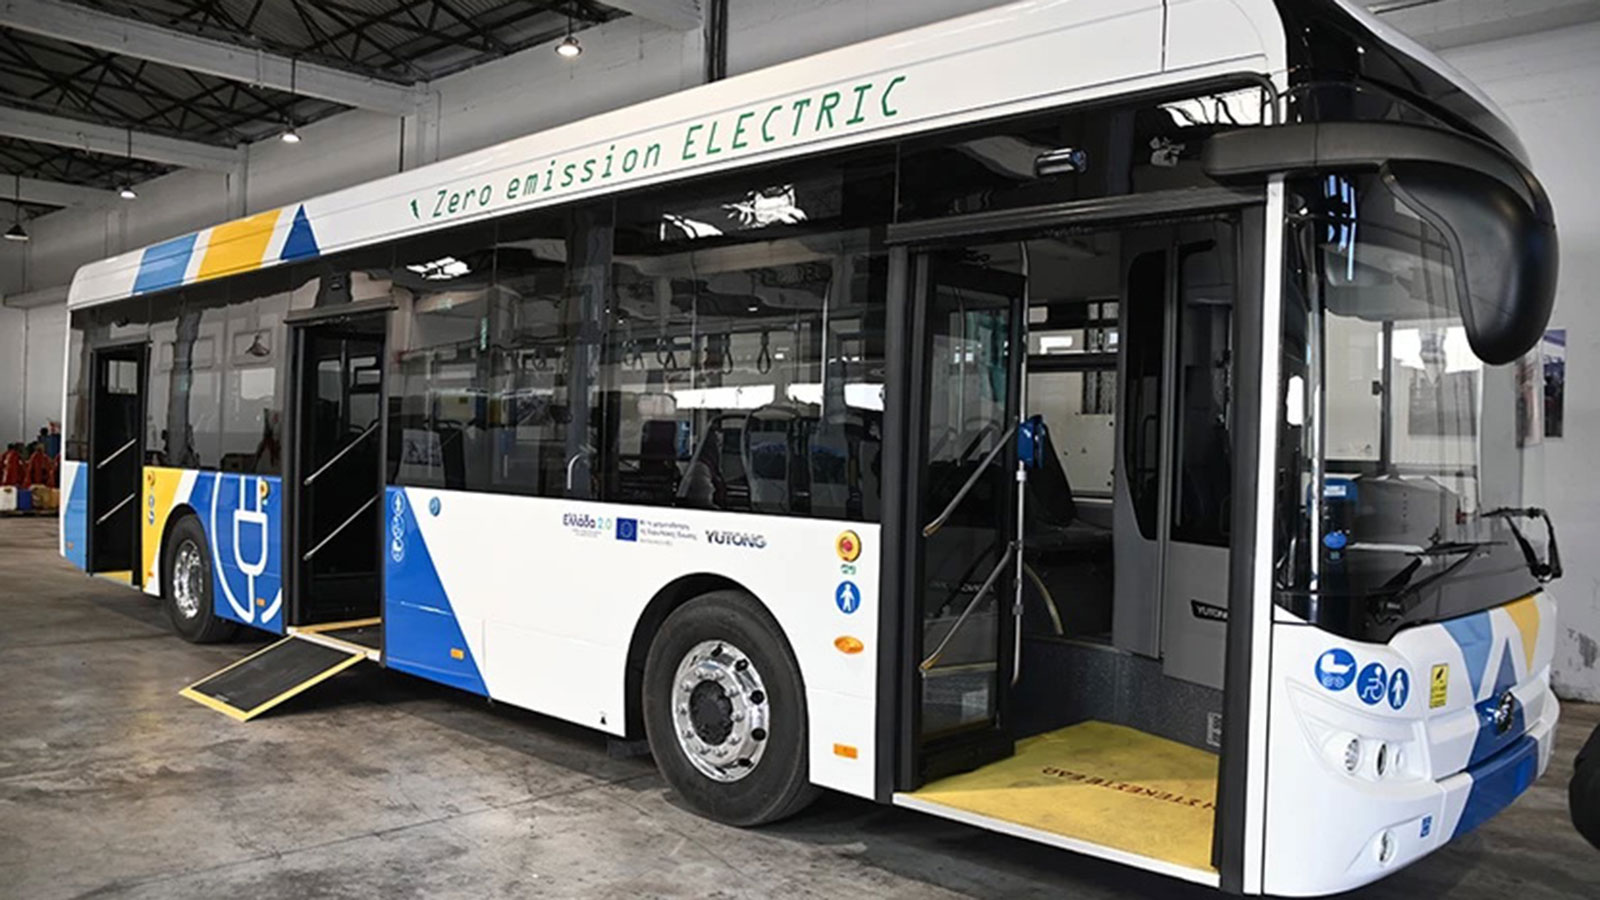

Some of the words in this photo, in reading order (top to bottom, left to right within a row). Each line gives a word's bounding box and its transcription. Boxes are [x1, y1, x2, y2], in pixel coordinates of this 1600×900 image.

[432, 184, 493, 218] Zero
[506, 142, 662, 200] emission
[681, 75, 907, 161] ELECTRIC
[704, 529, 768, 549] YUTONG
[1195, 604, 1229, 619] YUTON
